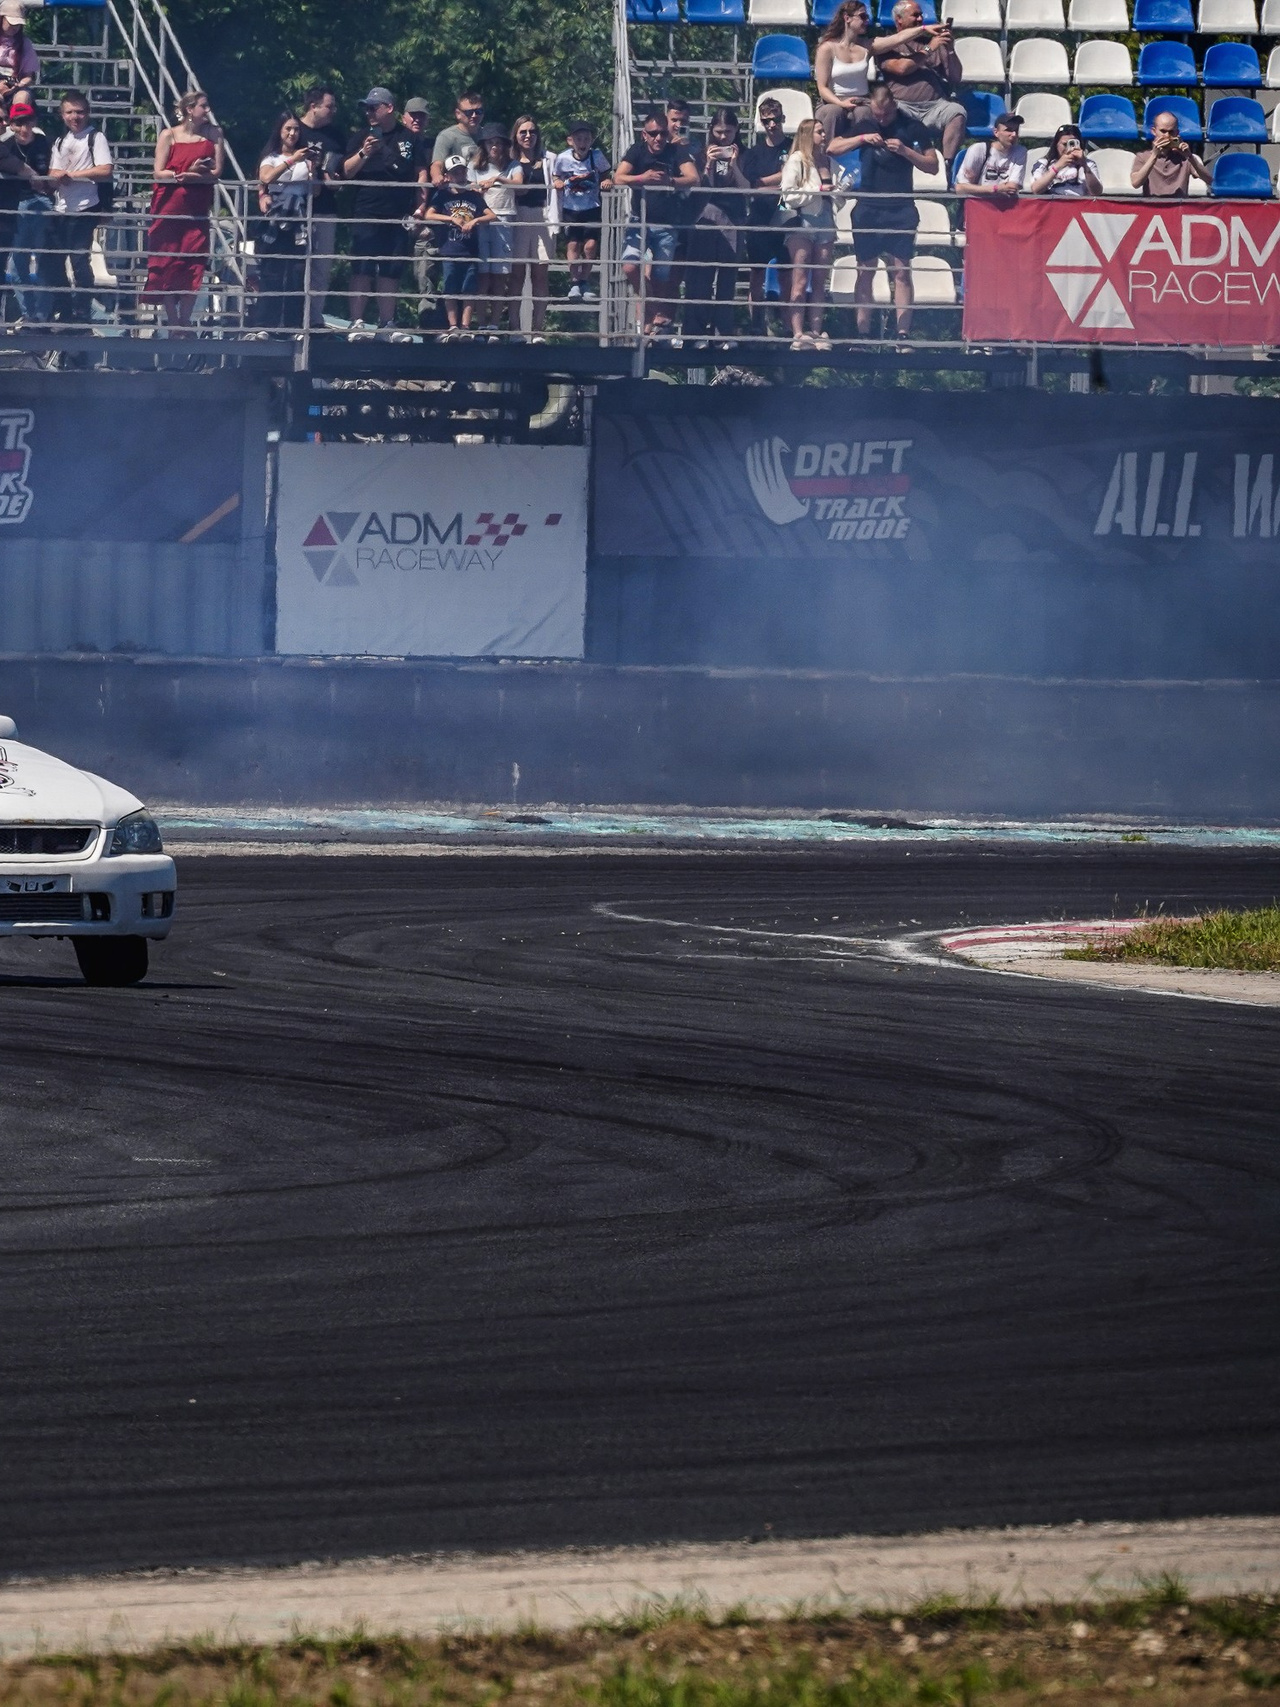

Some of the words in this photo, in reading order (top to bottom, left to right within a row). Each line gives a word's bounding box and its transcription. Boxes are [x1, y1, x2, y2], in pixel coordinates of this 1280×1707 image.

[1129, 214, 1280, 267] ADM
[794, 440, 912, 476] DRIFT
[815, 496, 906, 520] TRACK
[1093, 451, 1202, 538] ALL
[357, 511, 463, 545] ADM
[826, 518, 910, 540] MODE
[356, 548, 503, 571] RACEWAY
